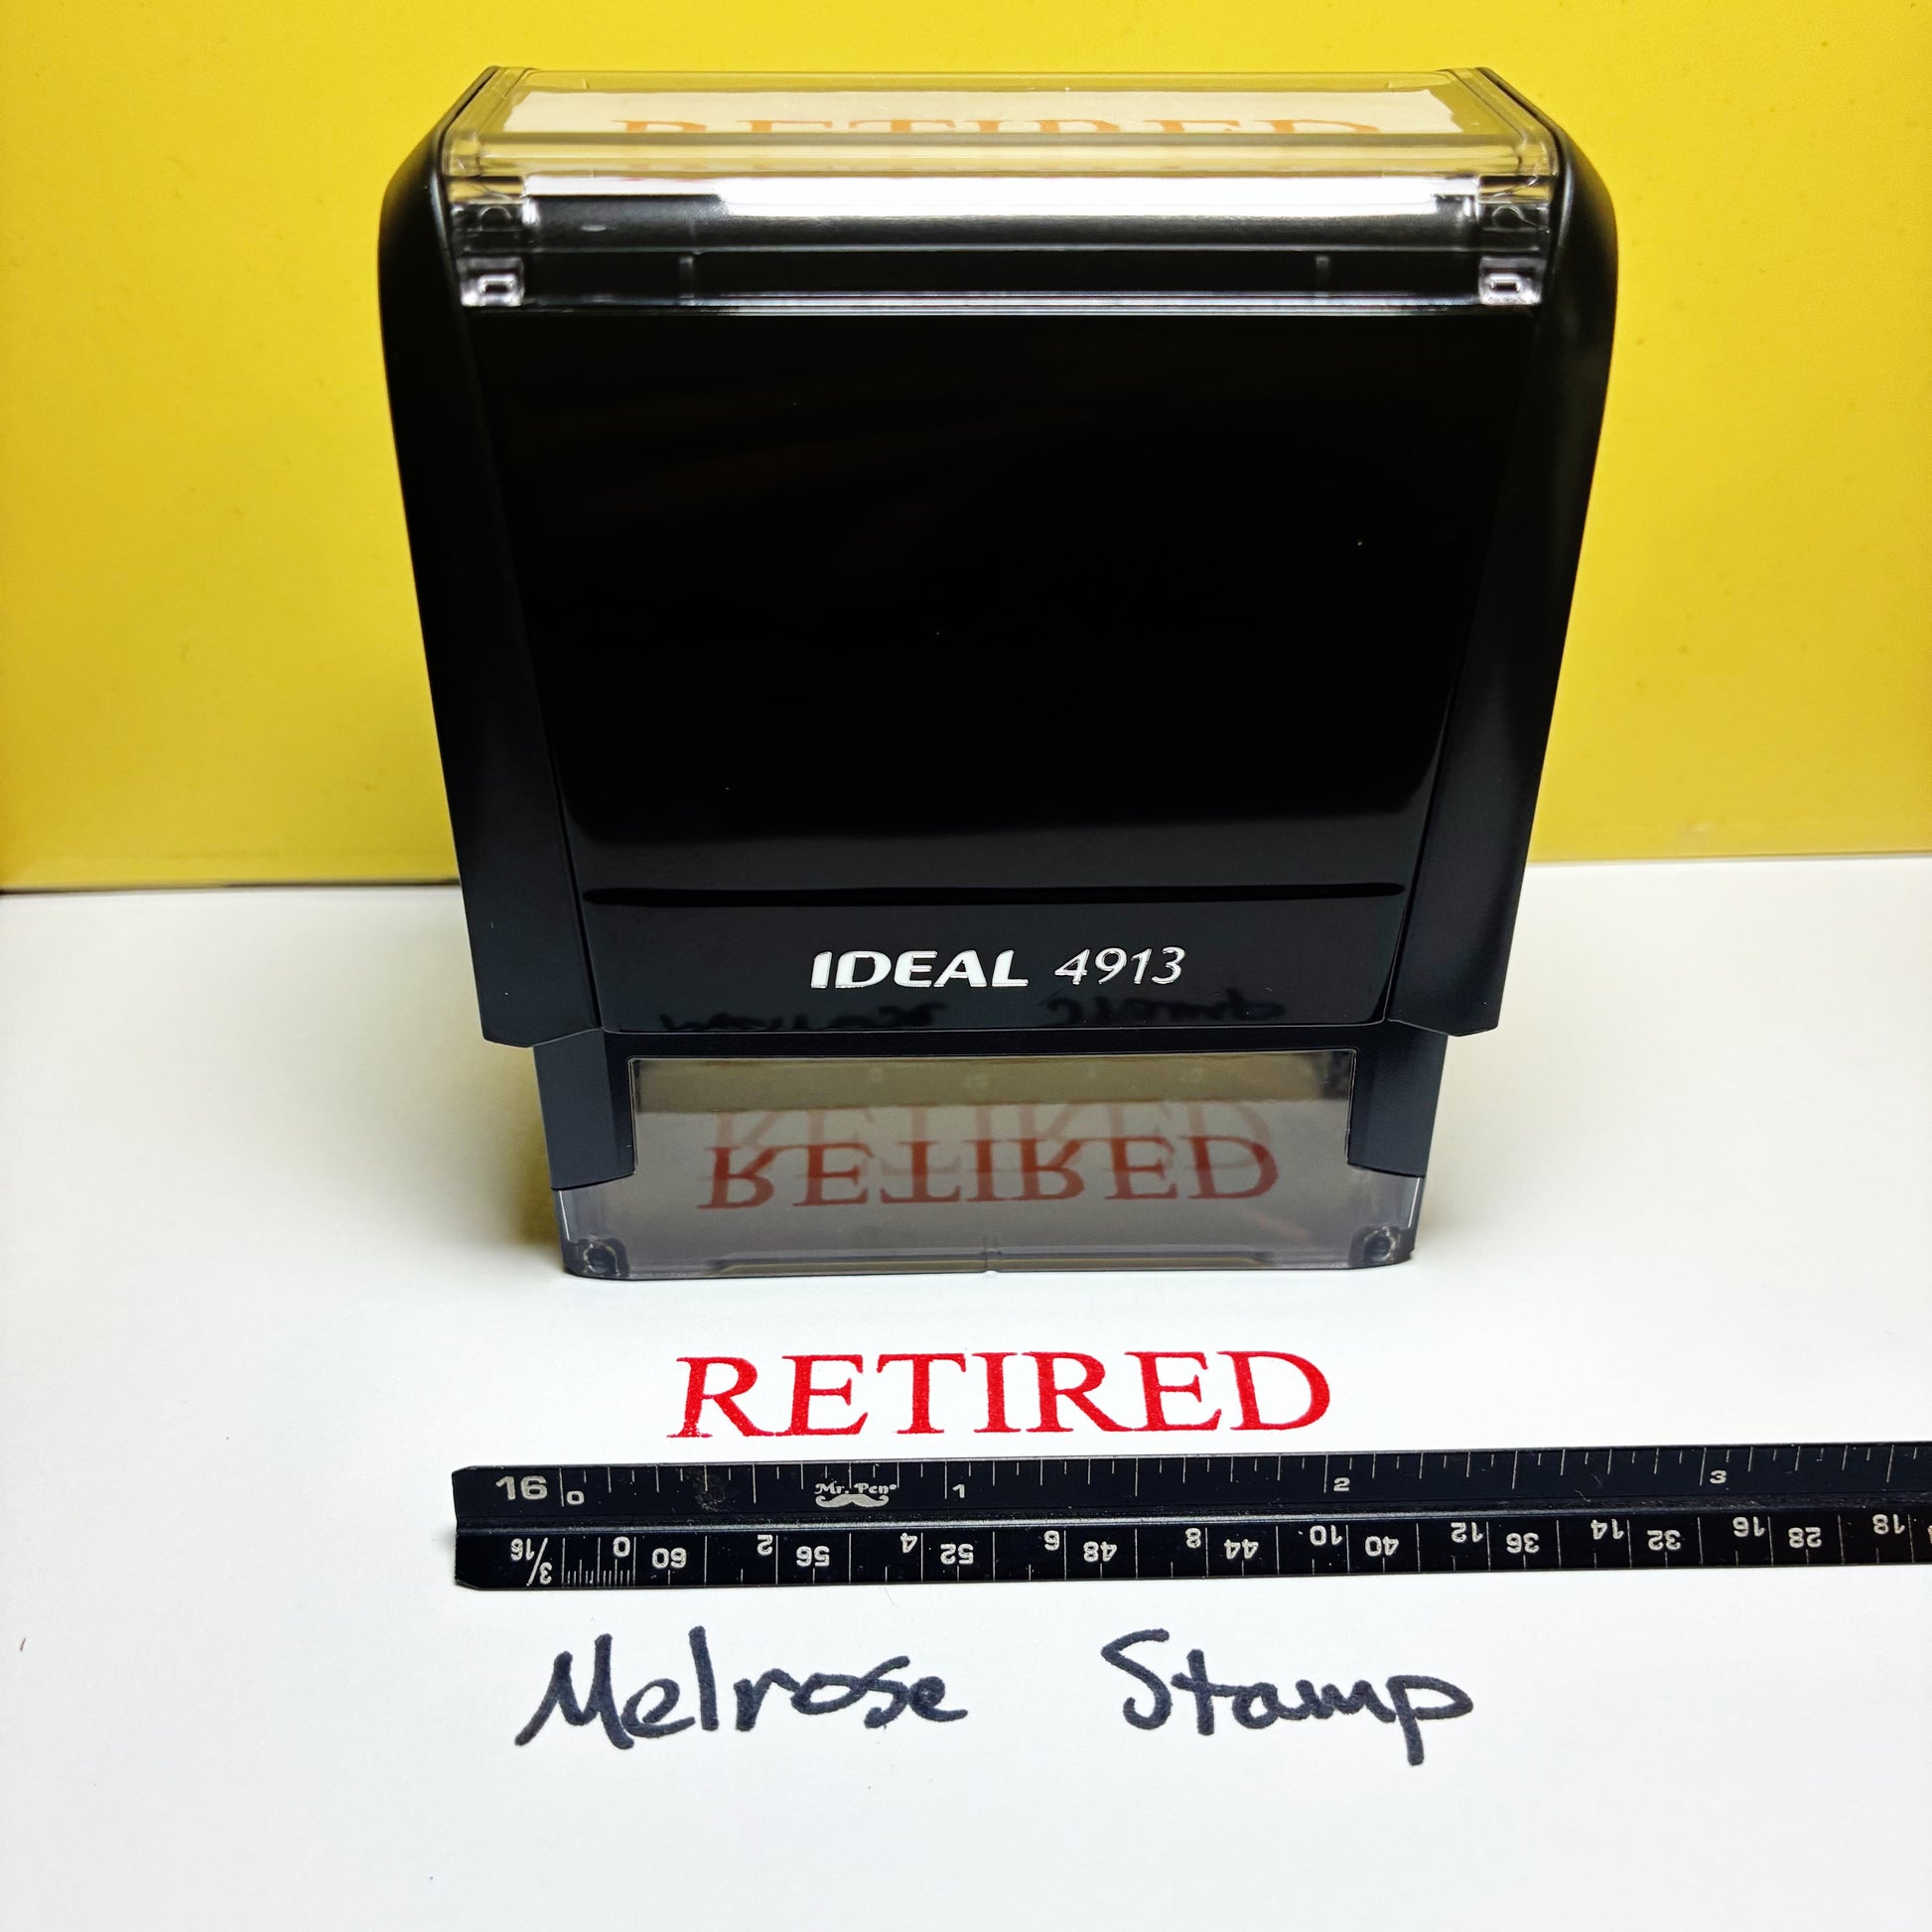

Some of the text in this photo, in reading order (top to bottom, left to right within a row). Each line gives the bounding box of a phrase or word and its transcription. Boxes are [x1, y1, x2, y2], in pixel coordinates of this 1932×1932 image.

[811, 947, 1184, 988] IDEAL 4913
[668, 1351, 1330, 1438] RETIRED
[1333, 1477, 1349, 1491] 2
[1710, 1470, 1726, 1483] 3
[496, 1476, 547, 1500] 16
[814, 1480, 849, 1494] Mr.
[953, 1484, 964, 1498] 1
[515, 1626, 1473, 1766] Melrose Stamp
